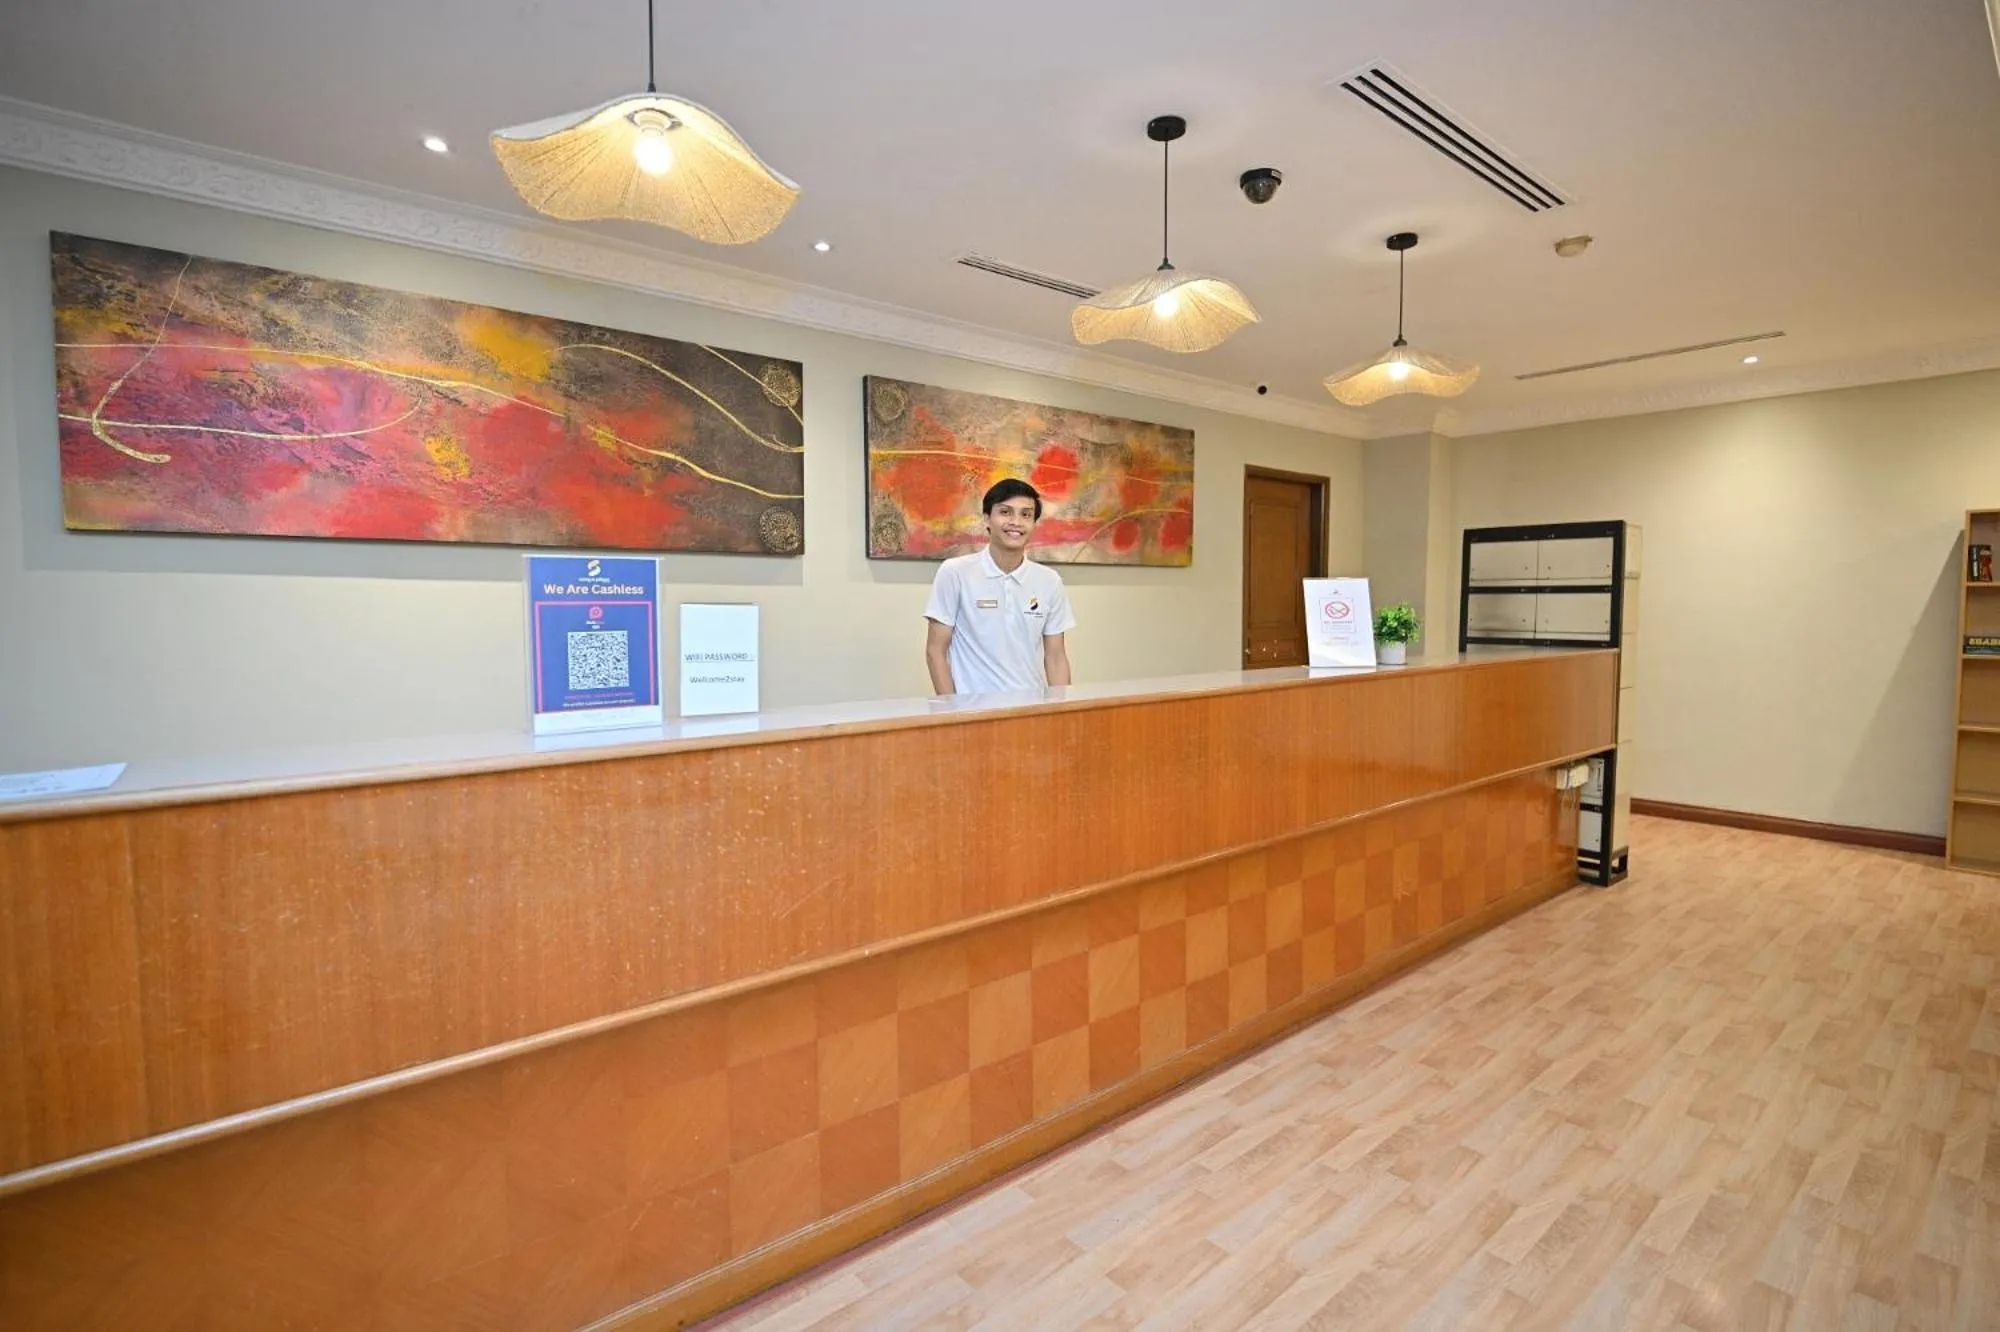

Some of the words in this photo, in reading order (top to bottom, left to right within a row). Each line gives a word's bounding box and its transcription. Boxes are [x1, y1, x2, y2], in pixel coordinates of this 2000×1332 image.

[543, 584, 564, 594] We
[566, 584, 589, 594] Are
[591, 584, 644, 594] Cashless
